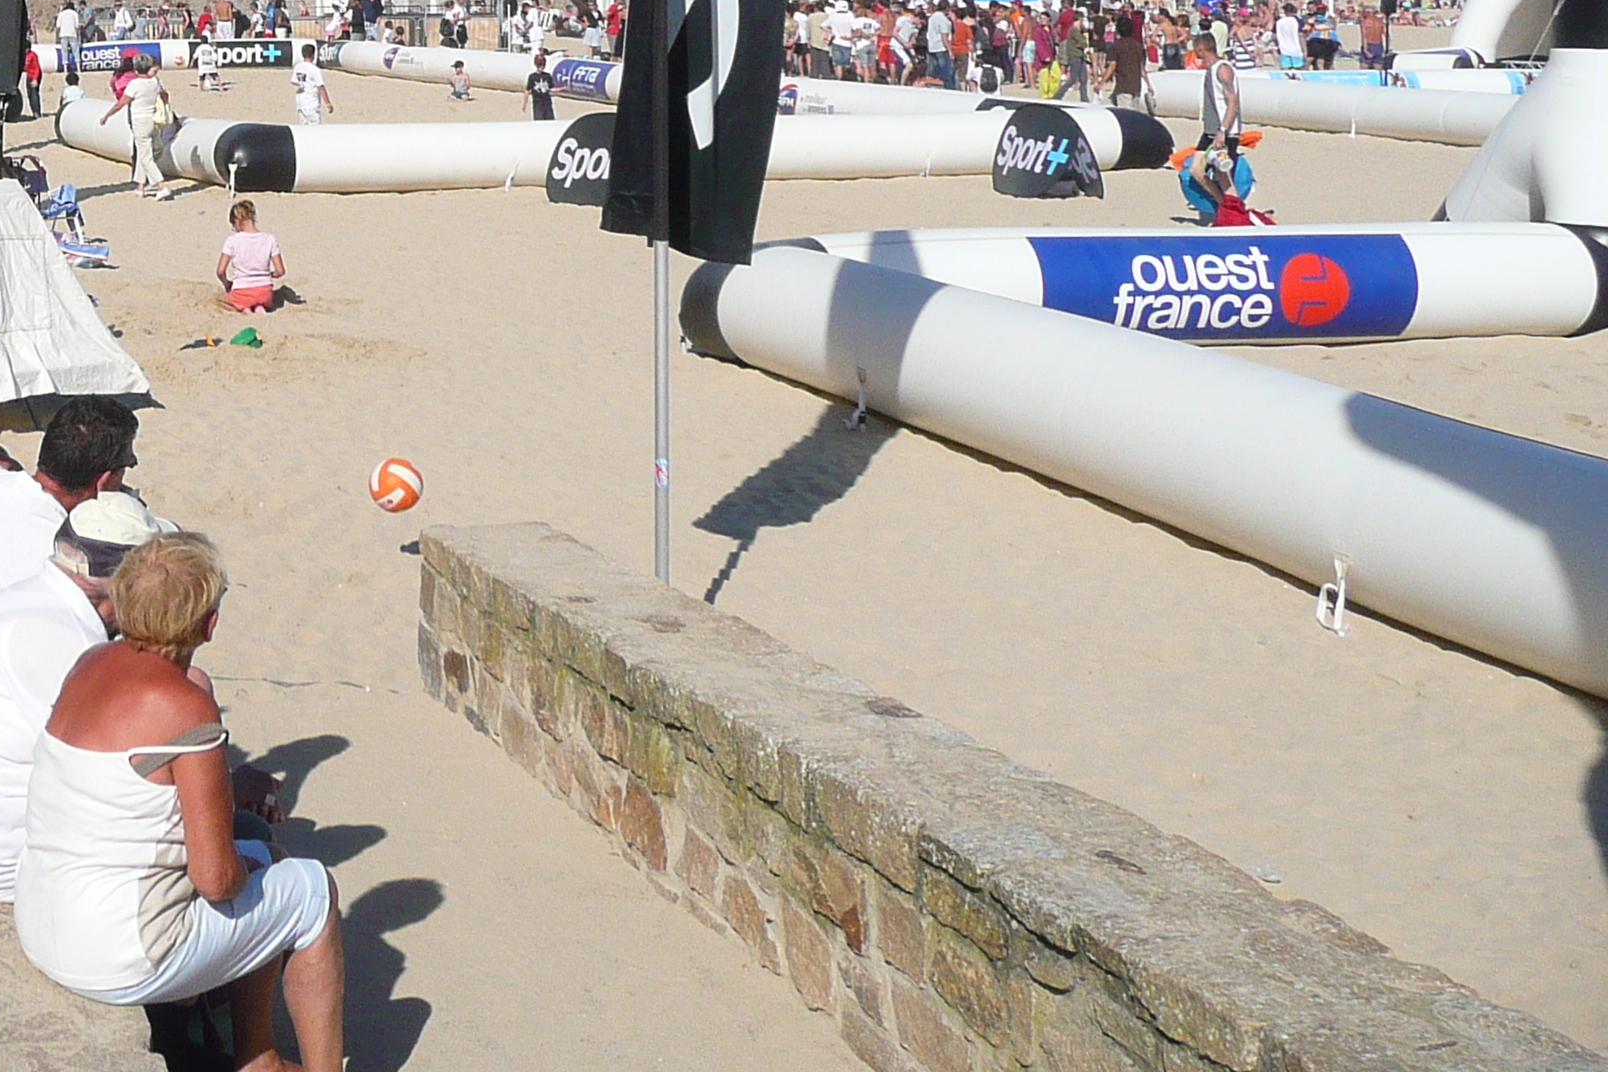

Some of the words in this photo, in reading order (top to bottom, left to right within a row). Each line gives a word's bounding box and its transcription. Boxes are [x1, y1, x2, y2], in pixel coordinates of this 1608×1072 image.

[81, 47, 122, 62] ouest
[215, 43, 282, 66] port+
[996, 124, 1070, 176] Sport+
[1131, 246, 1275, 292] ouest
[1112, 283, 1274, 329] france
